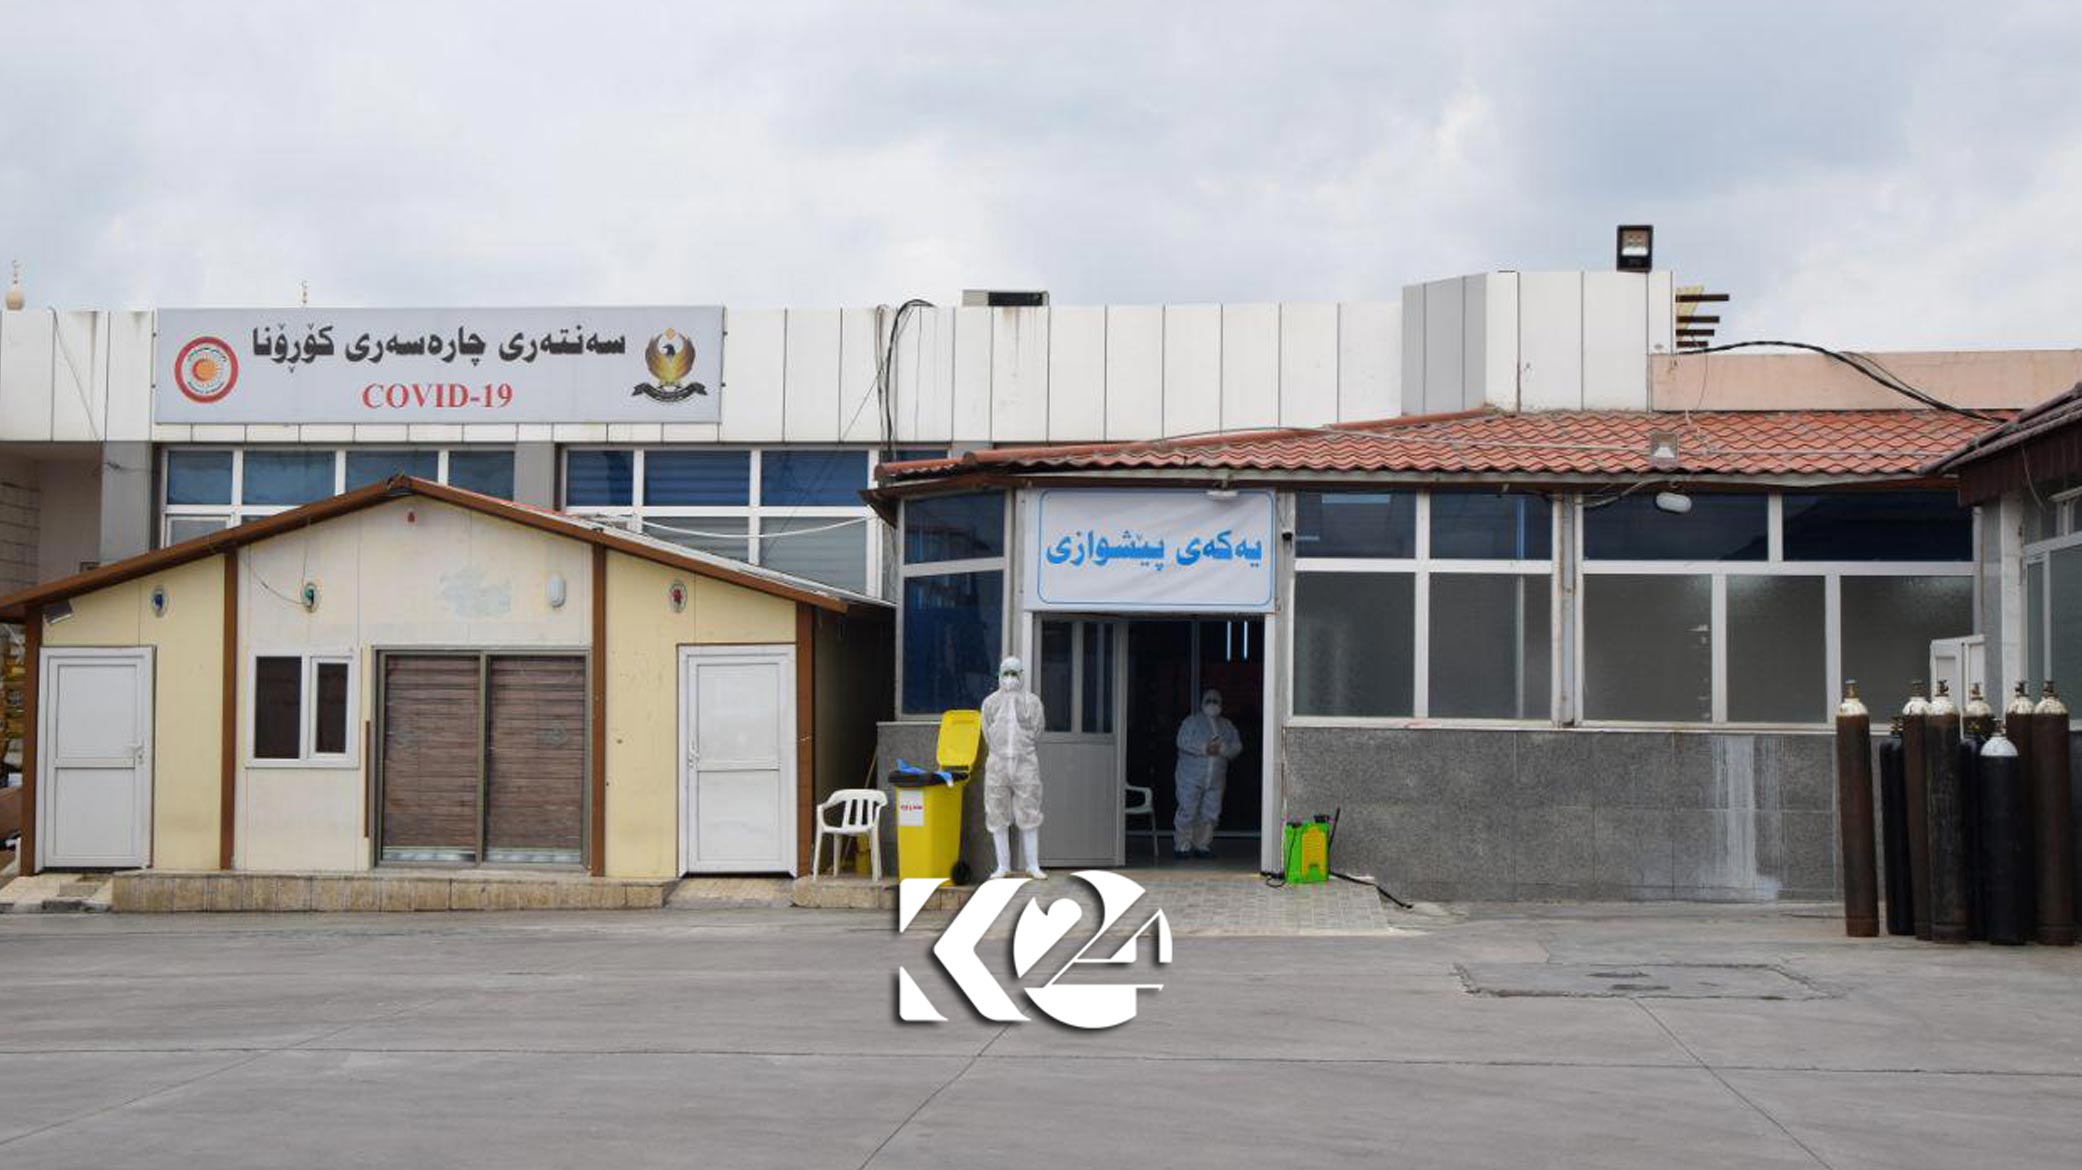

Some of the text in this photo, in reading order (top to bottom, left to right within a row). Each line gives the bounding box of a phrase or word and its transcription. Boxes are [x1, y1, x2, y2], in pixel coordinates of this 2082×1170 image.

[252, 323, 626, 374] سەنتەری چارەسەری کۆڕۆنا
[362, 383, 513, 409] COVID-19
[1045, 529, 1263, 571] یەکەی پێشوازی
